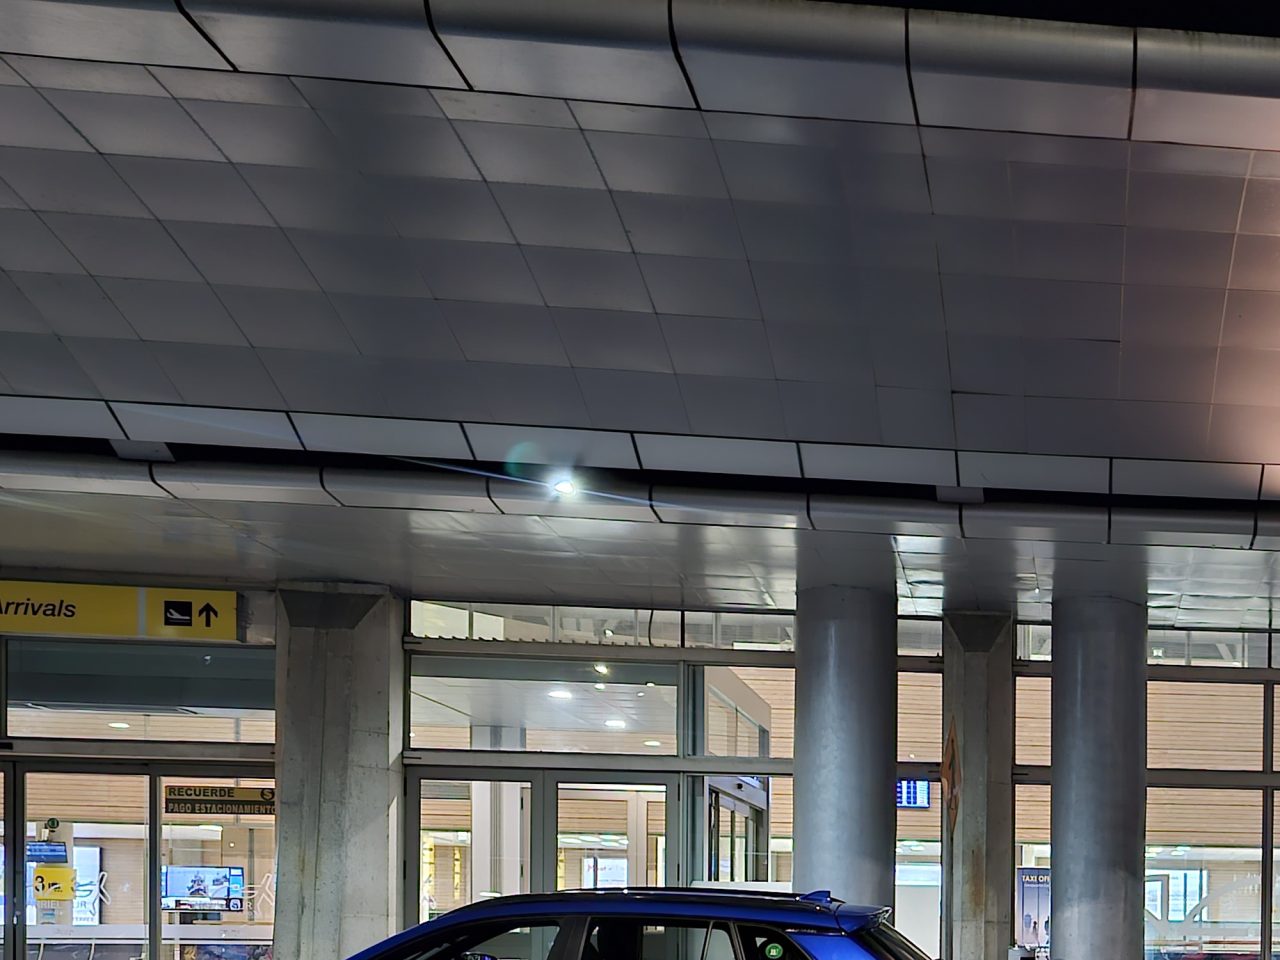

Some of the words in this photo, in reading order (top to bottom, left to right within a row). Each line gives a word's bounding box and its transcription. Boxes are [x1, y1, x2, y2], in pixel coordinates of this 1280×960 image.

[0, 598, 77, 618] rrivals
[168, 787, 235, 798] RECUERDE
[168, 803, 192, 813] PAGO
